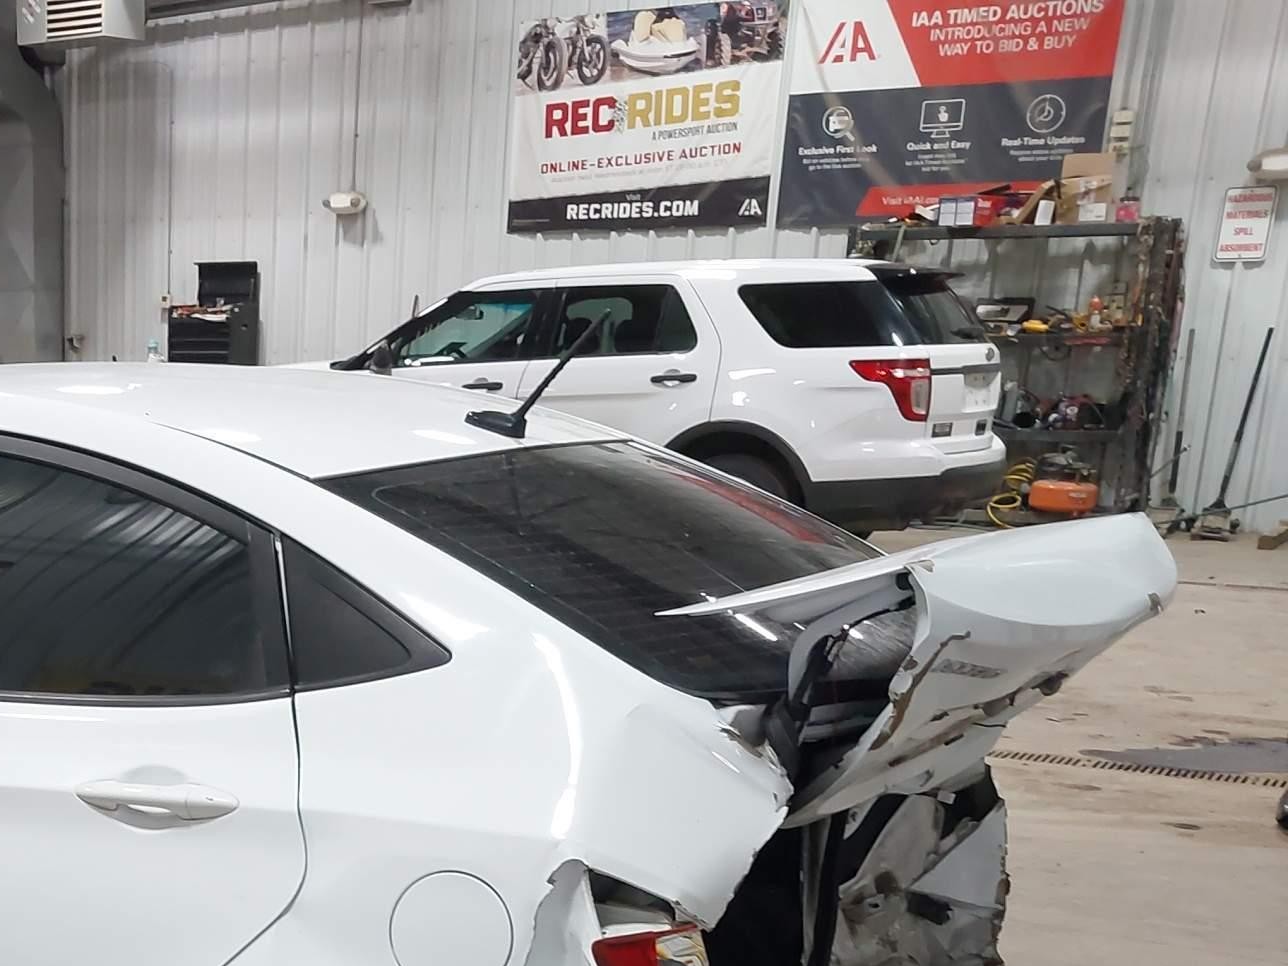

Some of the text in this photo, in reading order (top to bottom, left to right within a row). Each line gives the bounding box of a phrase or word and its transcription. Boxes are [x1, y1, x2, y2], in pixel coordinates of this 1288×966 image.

[912, 0, 1105, 28] IAA TIMED AUCTIONS
[930, 17, 1091, 42] INTRODUCING A NEW
[939, 34, 1078, 57] WAY TO BID & BUY
[544, 79, 742, 139] REC RIDES
[658, 125, 704, 140] POWERSPORT
[706, 121, 738, 135] AUCTION
[1001, 136, 1086, 146] Real-Time Updates
[798, 145, 835, 155] Exclusive
[906, 140, 972, 152] Quick and Easy
[540, 150, 675, 175] ONLINE-EXCLUSIVE
[678, 142, 742, 160] AUCTION
[566, 200, 700, 220] RECRIDES.COM
